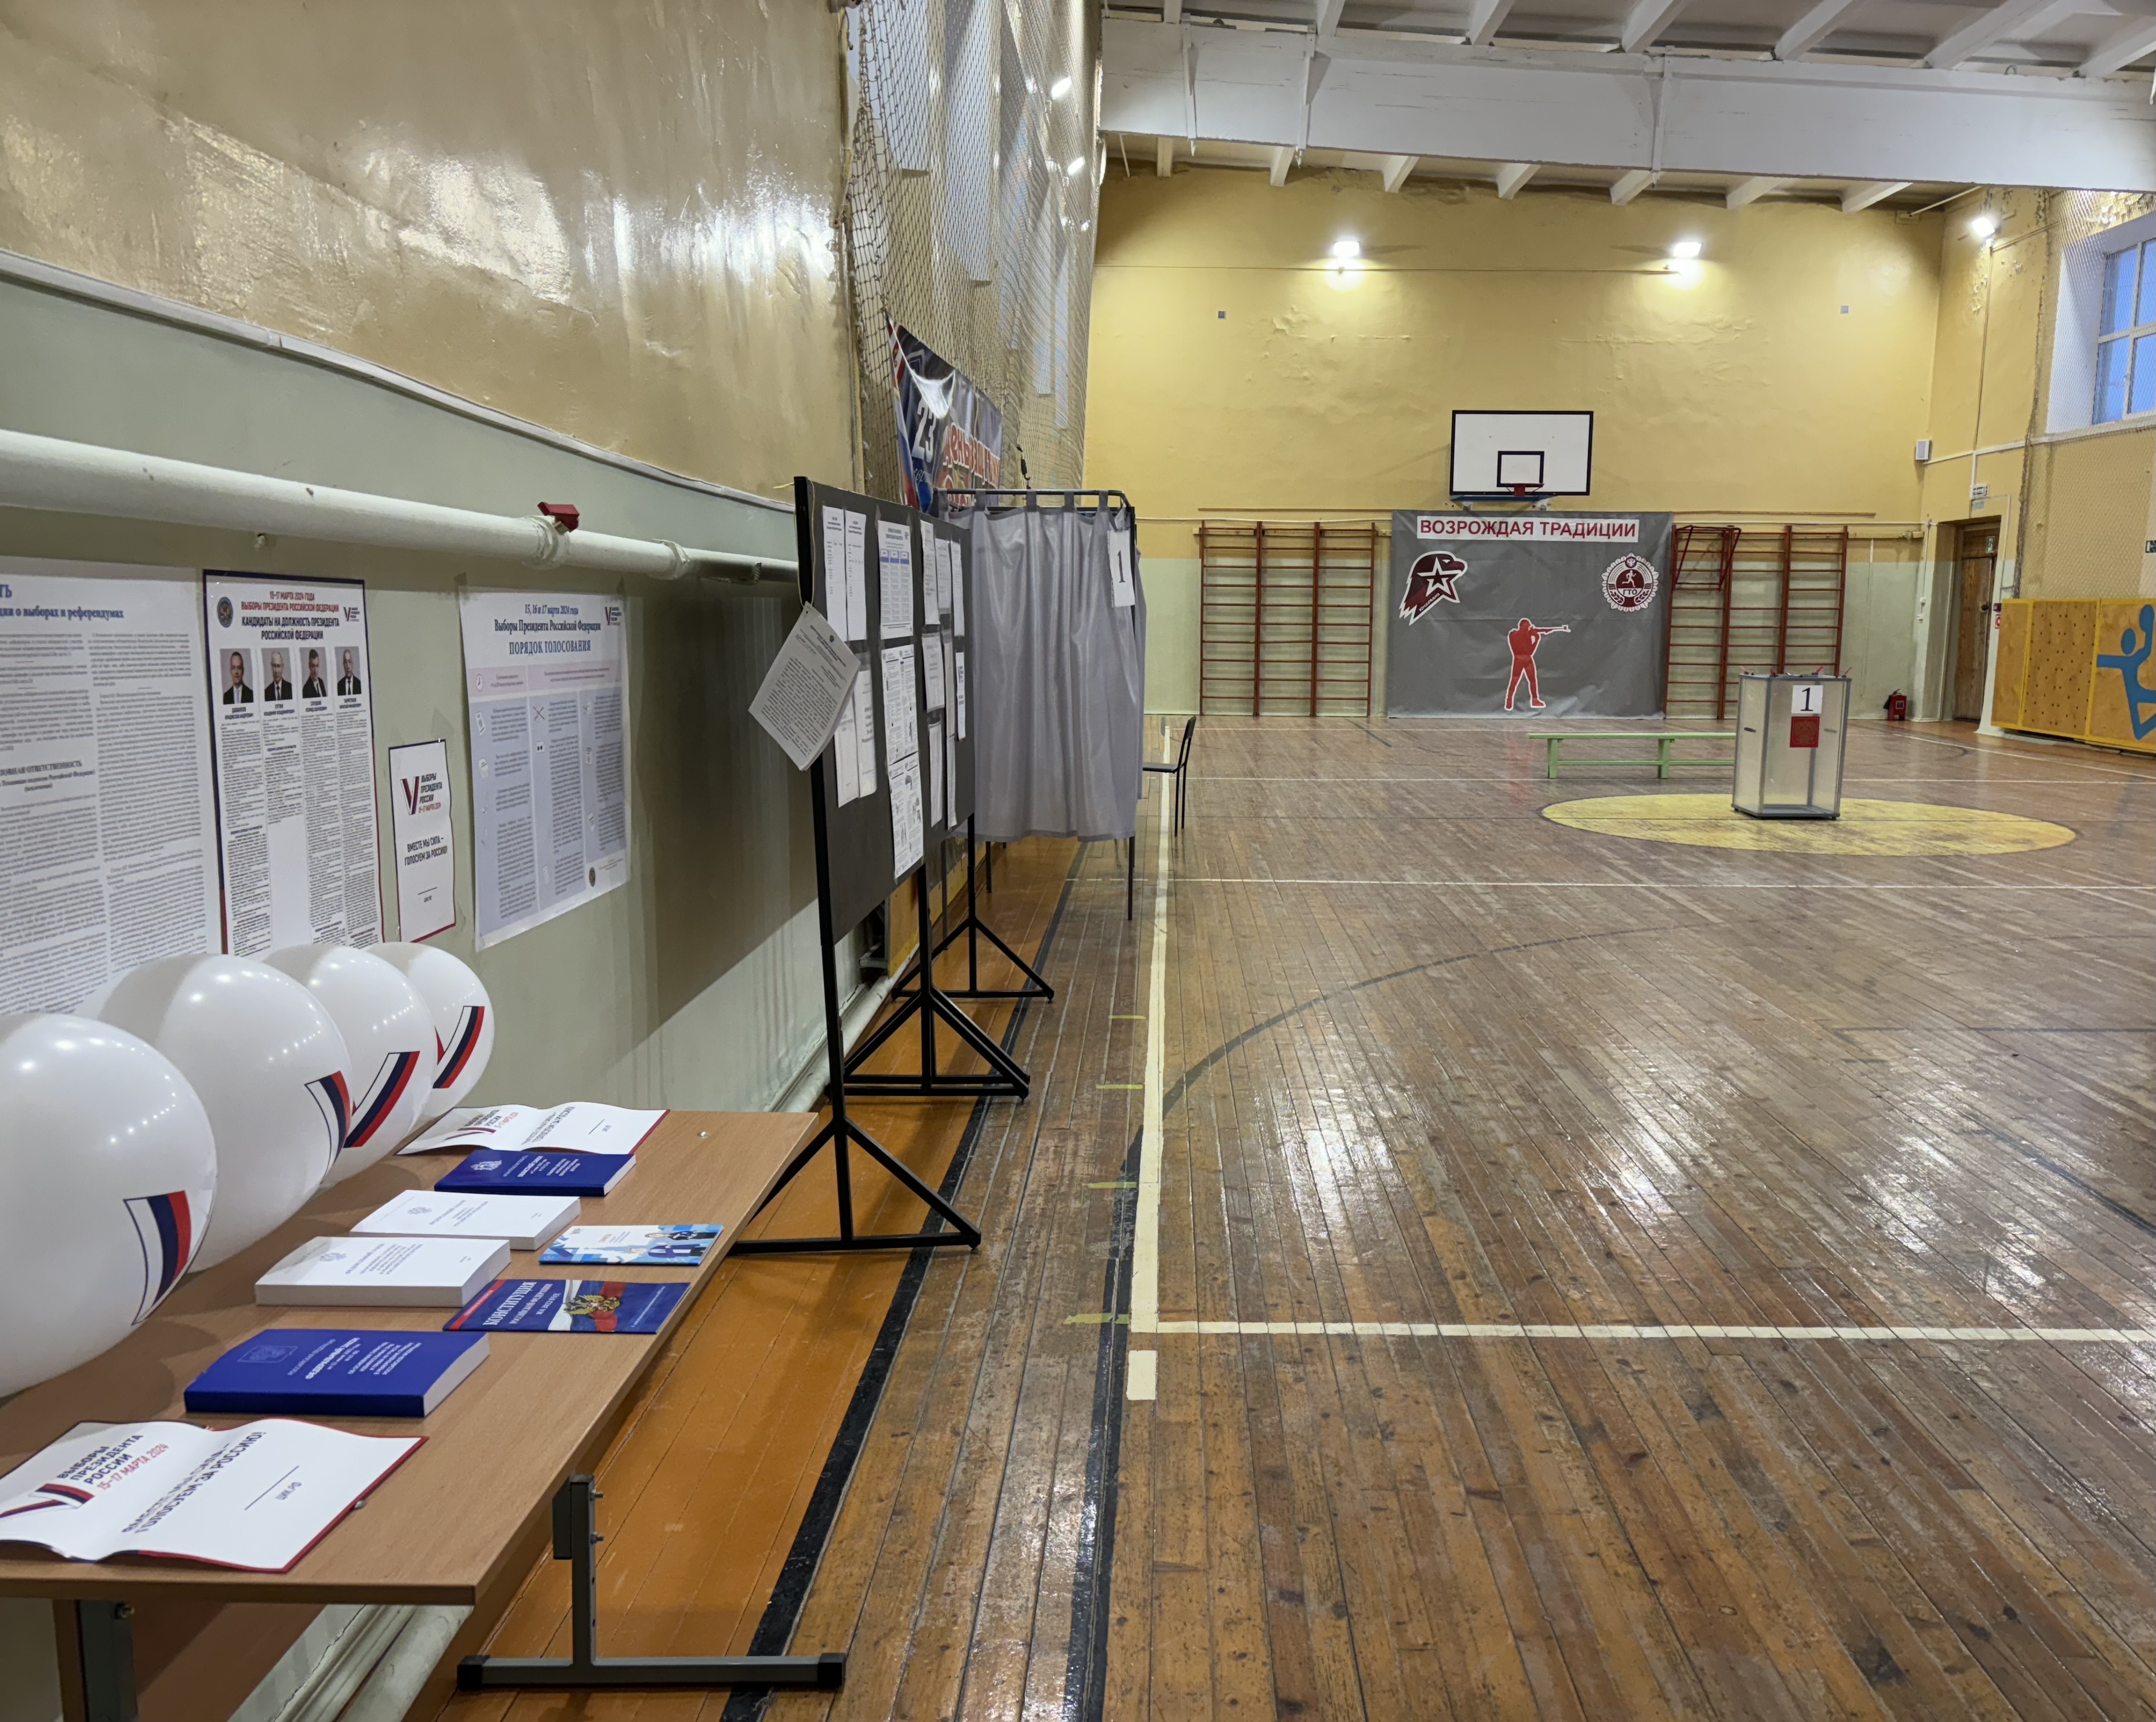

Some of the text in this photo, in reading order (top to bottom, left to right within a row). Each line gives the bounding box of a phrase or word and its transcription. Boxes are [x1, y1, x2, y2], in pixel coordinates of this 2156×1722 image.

[1420, 519, 1636, 539] ВОЗРОЖДАЯ ТРАДИЦИИ
[1117, 550, 1126, 583] 1
[23, 605, 59, 620] выборах
[68, 606, 124, 620] референдумах
[494, 619, 518, 634] Выборы
[518, 620, 549, 635] Президента
[509, 640, 591, 656] ПОРЯДОК ГОЛОСОВАНИЯ
[1800, 687, 1814, 711] 1
[407, 840, 423, 853] ВМЕСТЕ
[423, 838, 430, 848] МЫ
[430, 835, 441, 846] СИЛА
[426, 851, 431, 860] ЗА
[482, 1281, 537, 1325] КОНСТИТУЦИЯ
[56, 1446, 110, 1478] ВЫБОРЫ
[70, 1434, 144, 1481] ПРЕЗИДЕНТА
[83, 1453, 133, 1485] РОССИИ
[120, 1456, 150, 1477] МАРТА
[146, 1443, 169, 1459] 2024
[134, 1432, 267, 1534] ГОЛОСУЕМ ЗА РОССИЮ!
